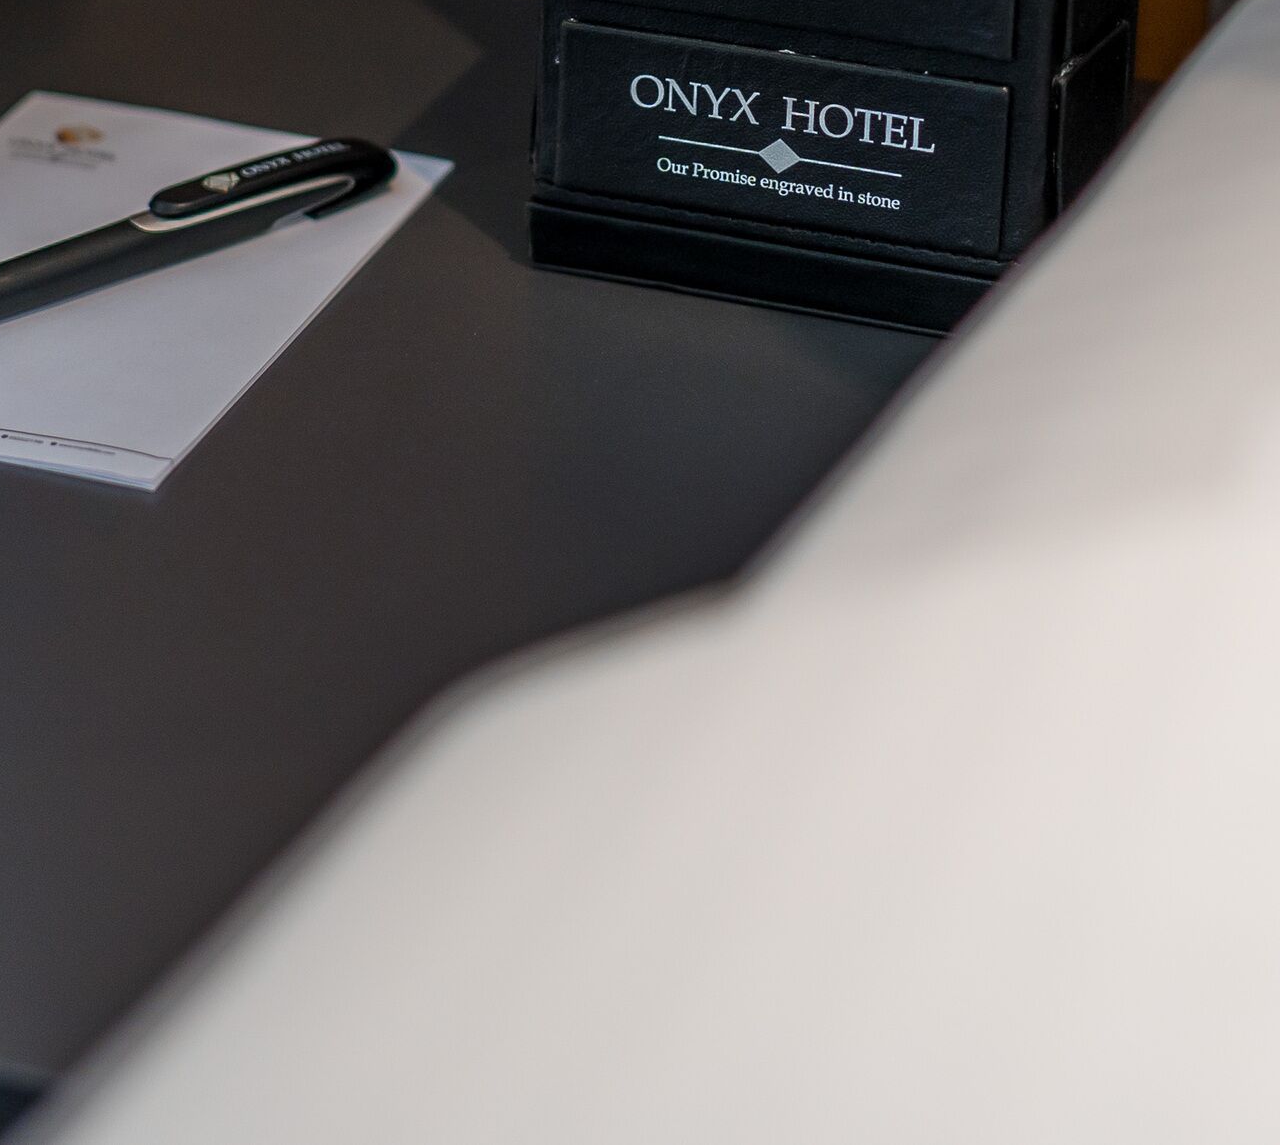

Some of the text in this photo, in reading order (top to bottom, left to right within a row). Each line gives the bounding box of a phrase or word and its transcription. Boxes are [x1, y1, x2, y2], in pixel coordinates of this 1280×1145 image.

[630, 74, 935, 153] ONYX HOTEL
[657, 157, 901, 210] Our Promise engraved in stone
